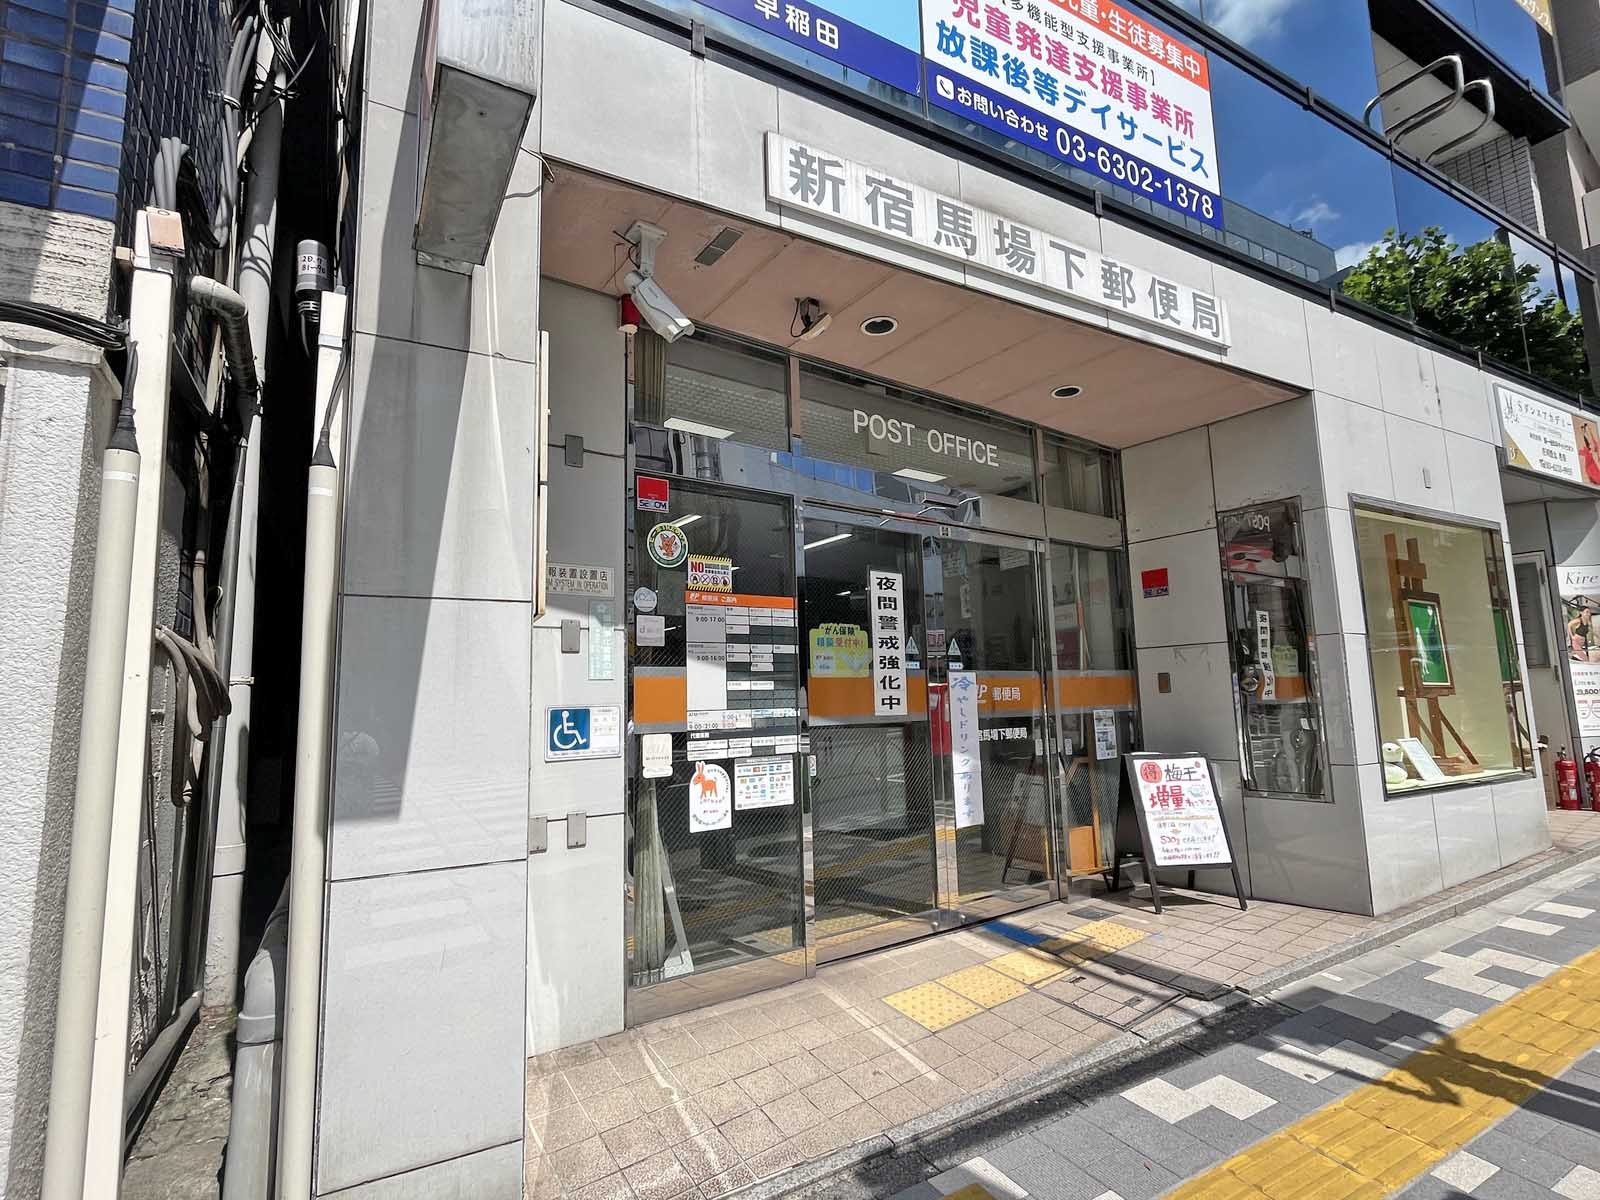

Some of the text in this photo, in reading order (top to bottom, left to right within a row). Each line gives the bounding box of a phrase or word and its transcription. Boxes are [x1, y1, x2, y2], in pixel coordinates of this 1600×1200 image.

[754, 0, 839, 50] 早稲田
[952, 0, 1195, 140] 児童発達支援事業所
[936, 19, 1209, 179] 放課後等デイサービス
[957, 86, 1214, 220] お問い合わせ 03-6302-1378
[788, 146, 1220, 338] 新宿馬場下郵便局
[853, 409, 1000, 467] POST OFFICE
[876, 575, 902, 711] 夜間警戒強化中
[1149, 784, 1185, 810] 増量
